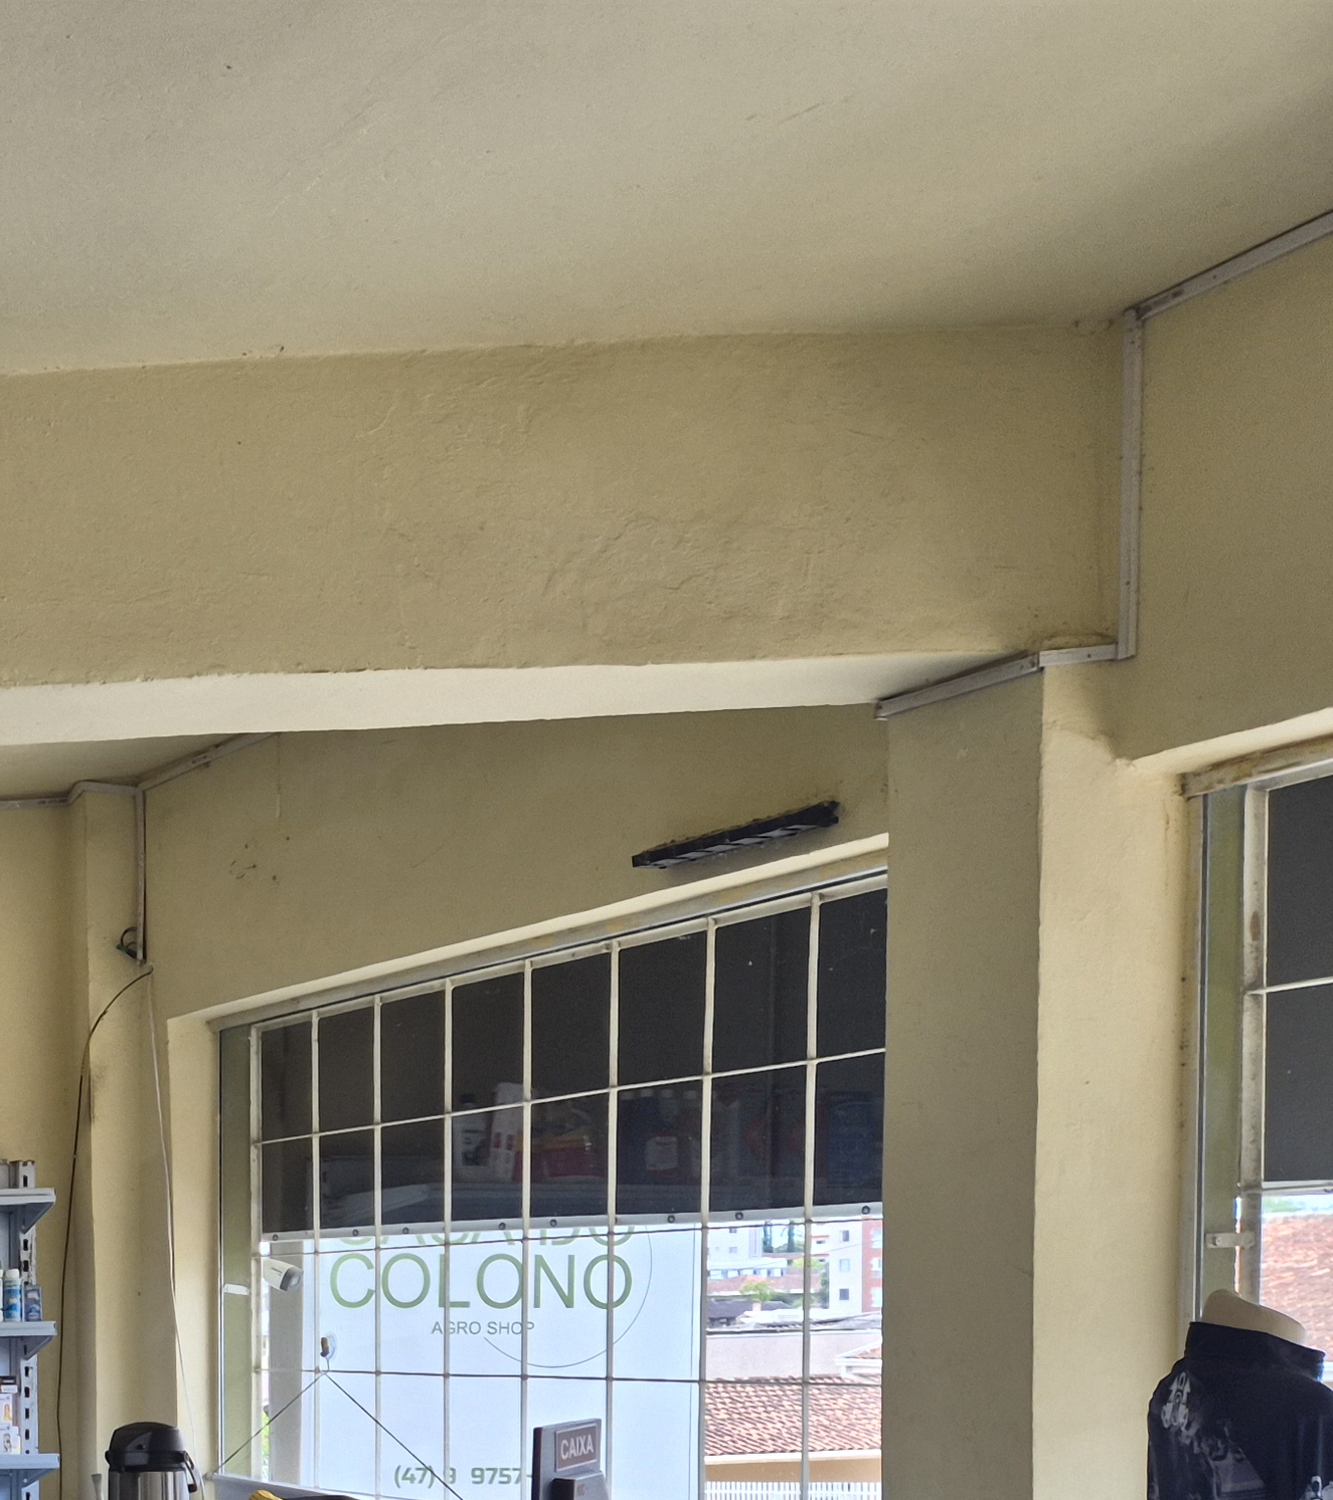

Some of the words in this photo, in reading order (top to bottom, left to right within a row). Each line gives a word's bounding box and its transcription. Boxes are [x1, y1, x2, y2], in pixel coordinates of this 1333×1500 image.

[329, 1253, 633, 1310] COLONO
[431, 1321, 481, 1335] AGRO
[487, 1321, 535, 1335] SHOP
[560, 1434, 595, 1460] CAIXA
[394, 1465, 434, 1488] (47)
